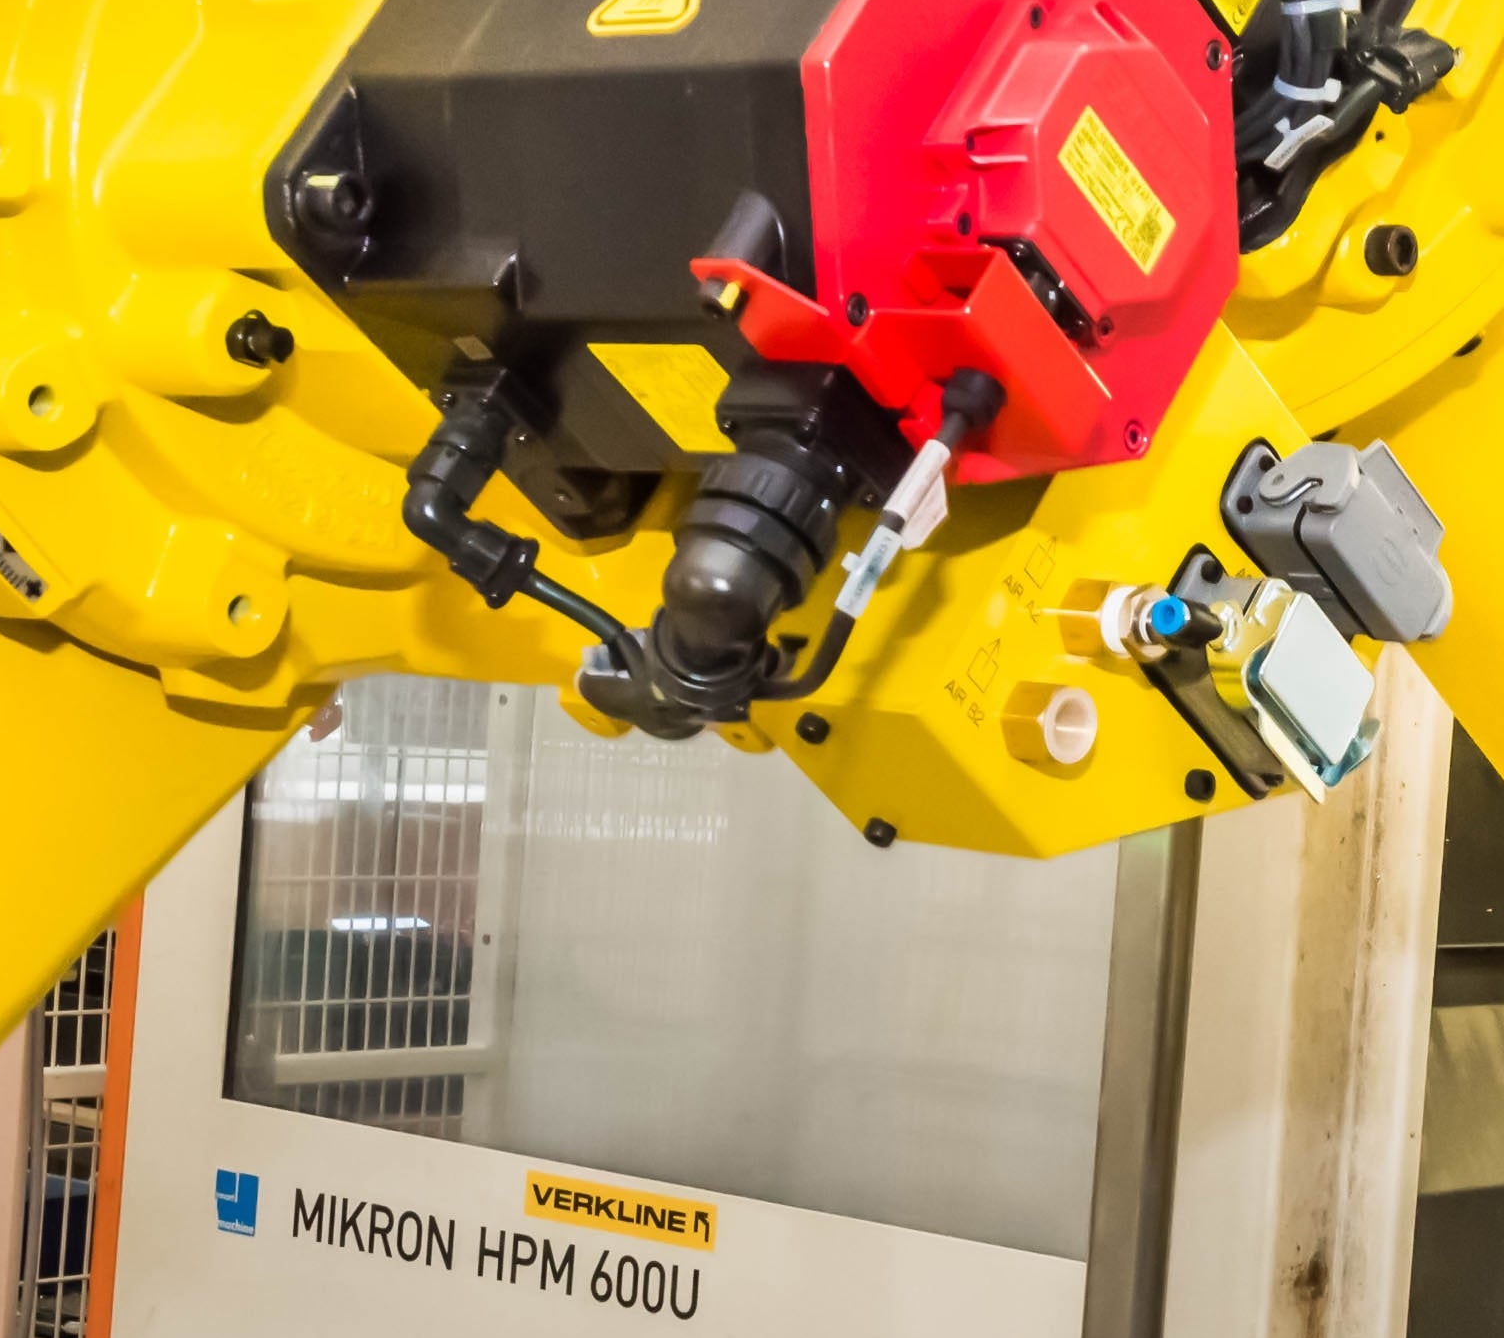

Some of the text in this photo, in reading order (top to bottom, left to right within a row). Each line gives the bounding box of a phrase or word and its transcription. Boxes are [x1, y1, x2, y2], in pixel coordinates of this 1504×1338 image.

[292, 1187, 701, 1320] MIKRON HPM 600U
[532, 1182, 687, 1234] VERKLINE
